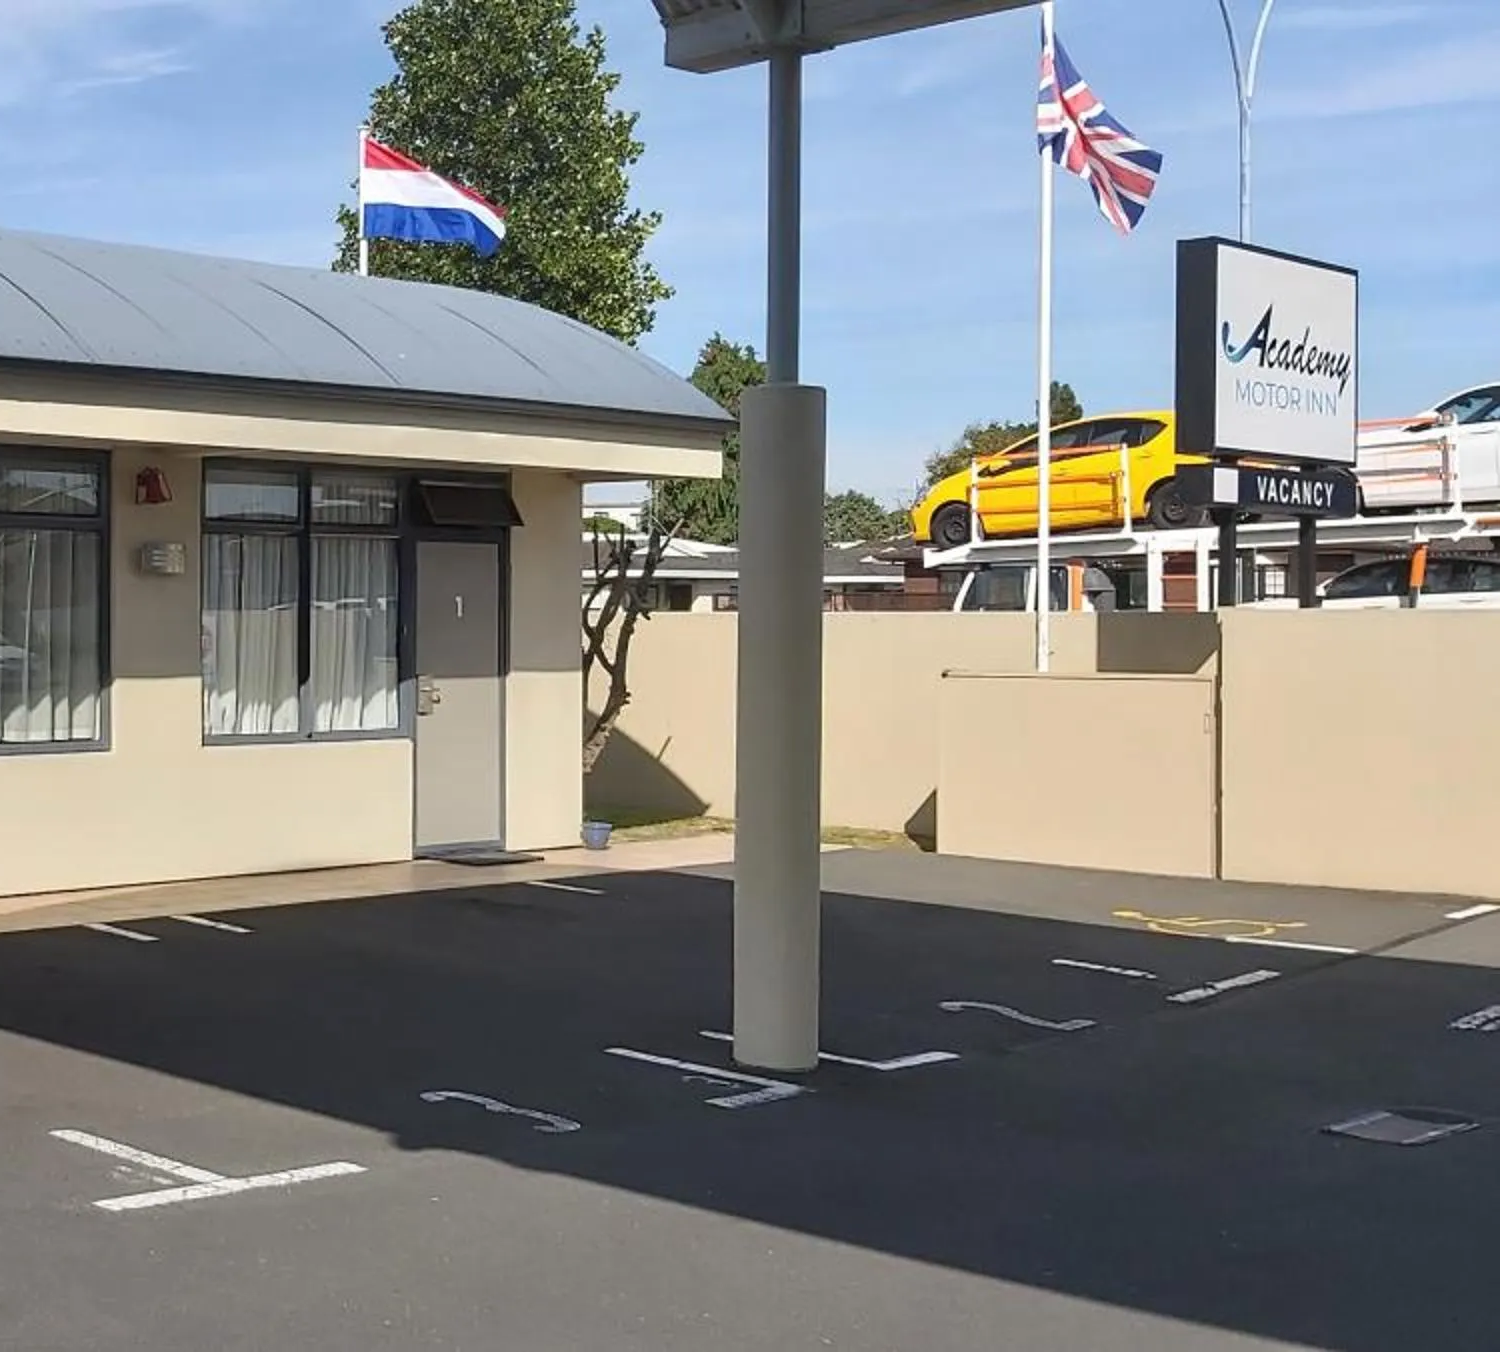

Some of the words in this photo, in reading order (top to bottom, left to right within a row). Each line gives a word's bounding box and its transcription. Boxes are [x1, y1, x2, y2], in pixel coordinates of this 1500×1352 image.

[1221, 303, 1351, 397] Academy
[1235, 379, 1301, 412] MOTOR
[1305, 388, 1338, 417] INN
[1257, 475, 1334, 508] VACANCY
[455, 595, 463, 617] 1
[937, 1001, 1097, 1031] 2
[419, 1090, 581, 1132] 3
